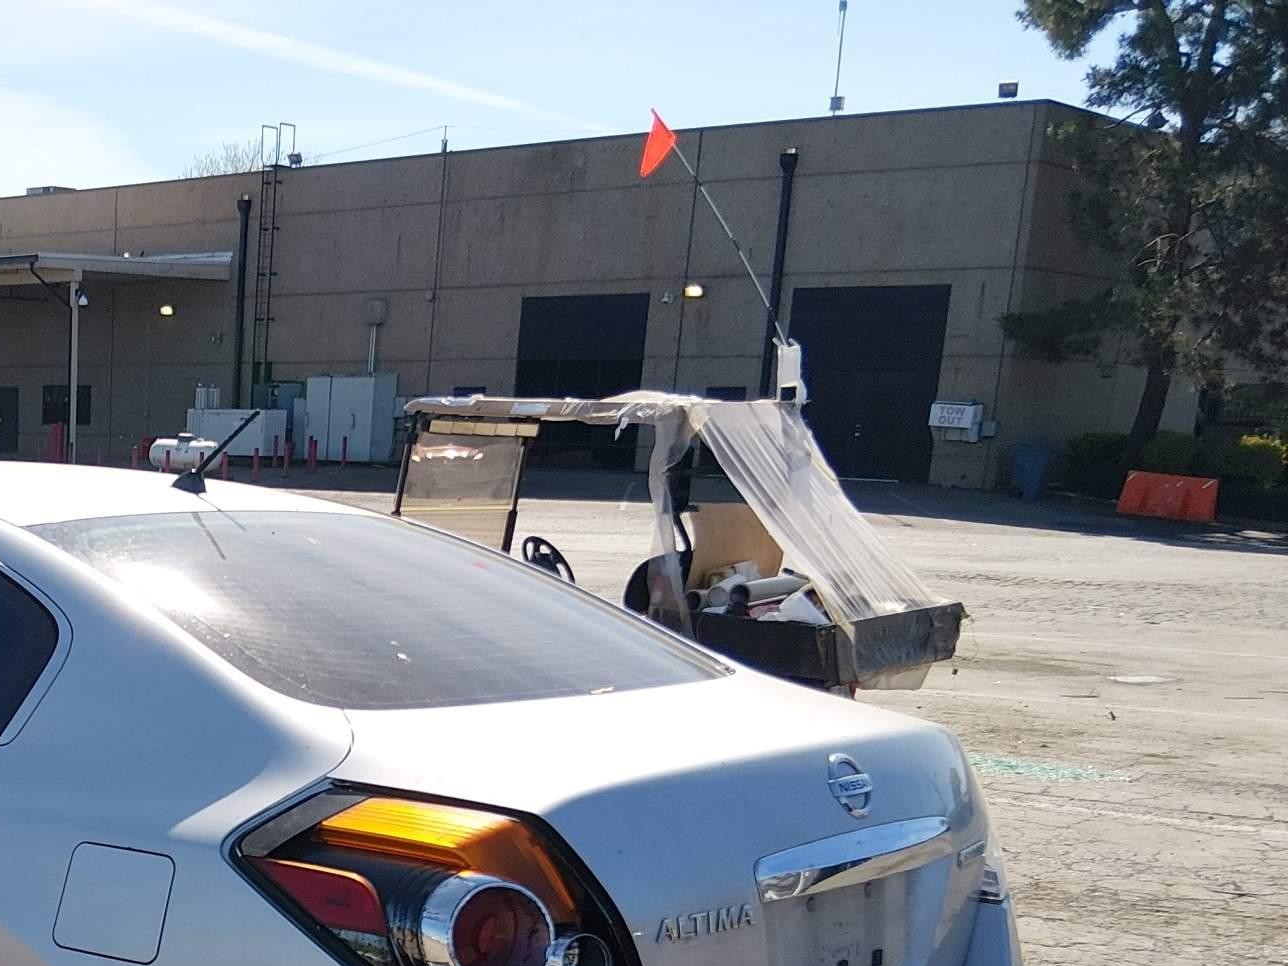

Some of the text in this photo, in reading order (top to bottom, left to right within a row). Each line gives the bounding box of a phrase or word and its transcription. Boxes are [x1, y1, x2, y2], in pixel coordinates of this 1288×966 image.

[939, 406, 967, 416] TOW
[938, 415, 963, 425] OUT
[655, 903, 755, 944] ALTIMA
